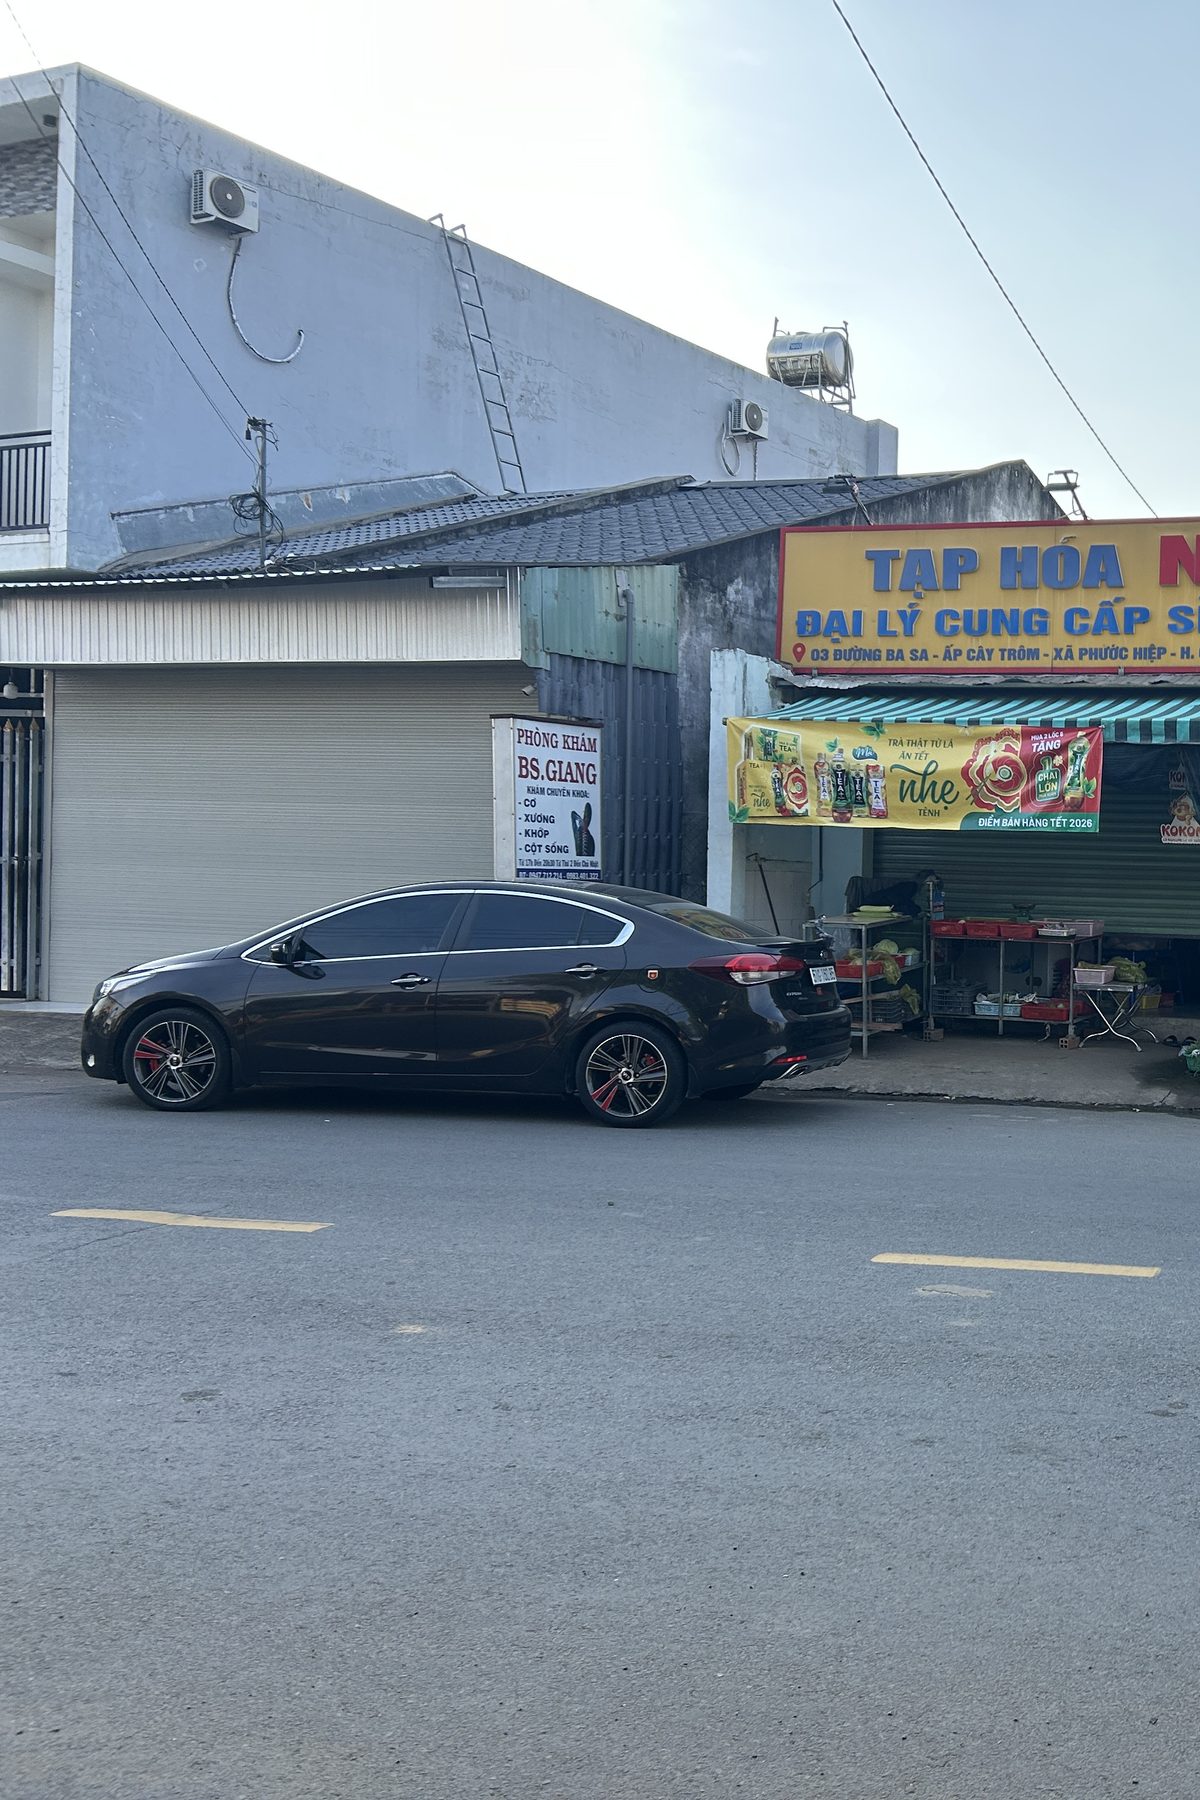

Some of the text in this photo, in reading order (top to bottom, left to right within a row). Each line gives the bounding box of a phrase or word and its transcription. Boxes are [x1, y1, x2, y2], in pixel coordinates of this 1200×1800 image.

[865, 547, 979, 600] TẠP
[1000, 535, 1124, 590] HÓA
[796, 608, 864, 644] ĐẠI
[877, 602, 921, 637] LÝ
[933, 607, 1050, 636] CUNG
[1063, 596, 1151, 636] CẤP
[810, 648, 829, 661] 03
[832, 645, 882, 661] ĐƯỜNG
[886, 649, 905, 661] BA
[910, 649, 929, 661] SA
[943, 644, 962, 661] ẤP
[967, 645, 994, 661] CÂY
[999, 645, 1040, 661] TRÔM
[1053, 645, 1074, 660] XÃ
[1078, 643, 1128, 660] PHƯỚC
[1133, 643, 1167, 662] HIỆP
[1180, 646, 1194, 659] H.
[516, 726, 598, 753] PHÒNG KHÁM
[888, 737, 904, 748] TRÀ
[906, 737, 928, 750] THẬT
[943, 738, 954, 749] LÁ
[1031, 739, 1061, 755] TẶNG
[898, 750, 929, 760] ĂN TẾT
[517, 755, 598, 785] BS.GIANG
[1038, 771, 1058, 781] CHAI
[526, 785, 546, 796] KHÁM
[546, 787, 571, 798] CHUYÊN
[890, 759, 960, 811] nhẹ
[524, 813, 555, 824] XƯƠNG
[918, 807, 941, 817] TÊNH
[978, 815, 1093, 828] ĐIỂM BÁN HÀNG TẾT 2026
[524, 829, 550, 839] KHỚP
[524, 843, 542, 855] CỘT
[545, 841, 569, 854] SỐNG
